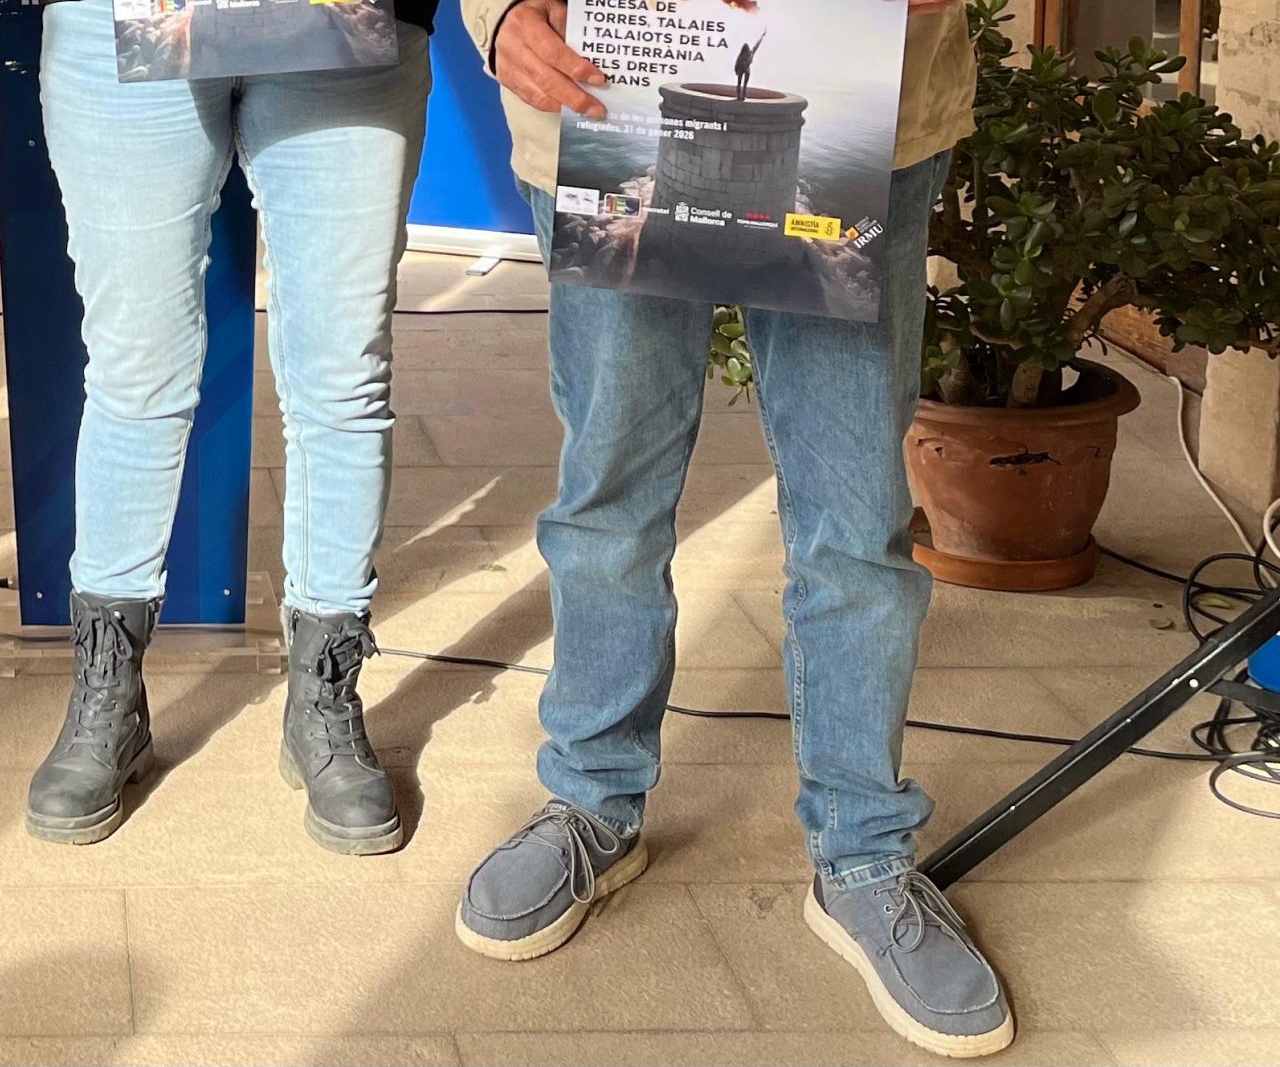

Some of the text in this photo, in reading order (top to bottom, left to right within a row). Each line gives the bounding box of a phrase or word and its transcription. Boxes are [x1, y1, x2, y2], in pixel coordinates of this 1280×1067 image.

[656, 1, 677, 12] DE
[584, 11, 725, 32] TORRES, TALAIES
[594, 27, 672, 44] TALAIOTS
[680, 35, 700, 46] DE
[707, 37, 728, 48] LA
[582, 42, 704, 62] MEDITERRÀNIA
[627, 61, 678, 75] DRETS
[604, 74, 650, 87] MANS
[685, 120, 721, 131] migrants
[690, 207, 732, 219] Consell de
[690, 215, 725, 226] Mallorca
[853, 223, 884, 248] IRMU
